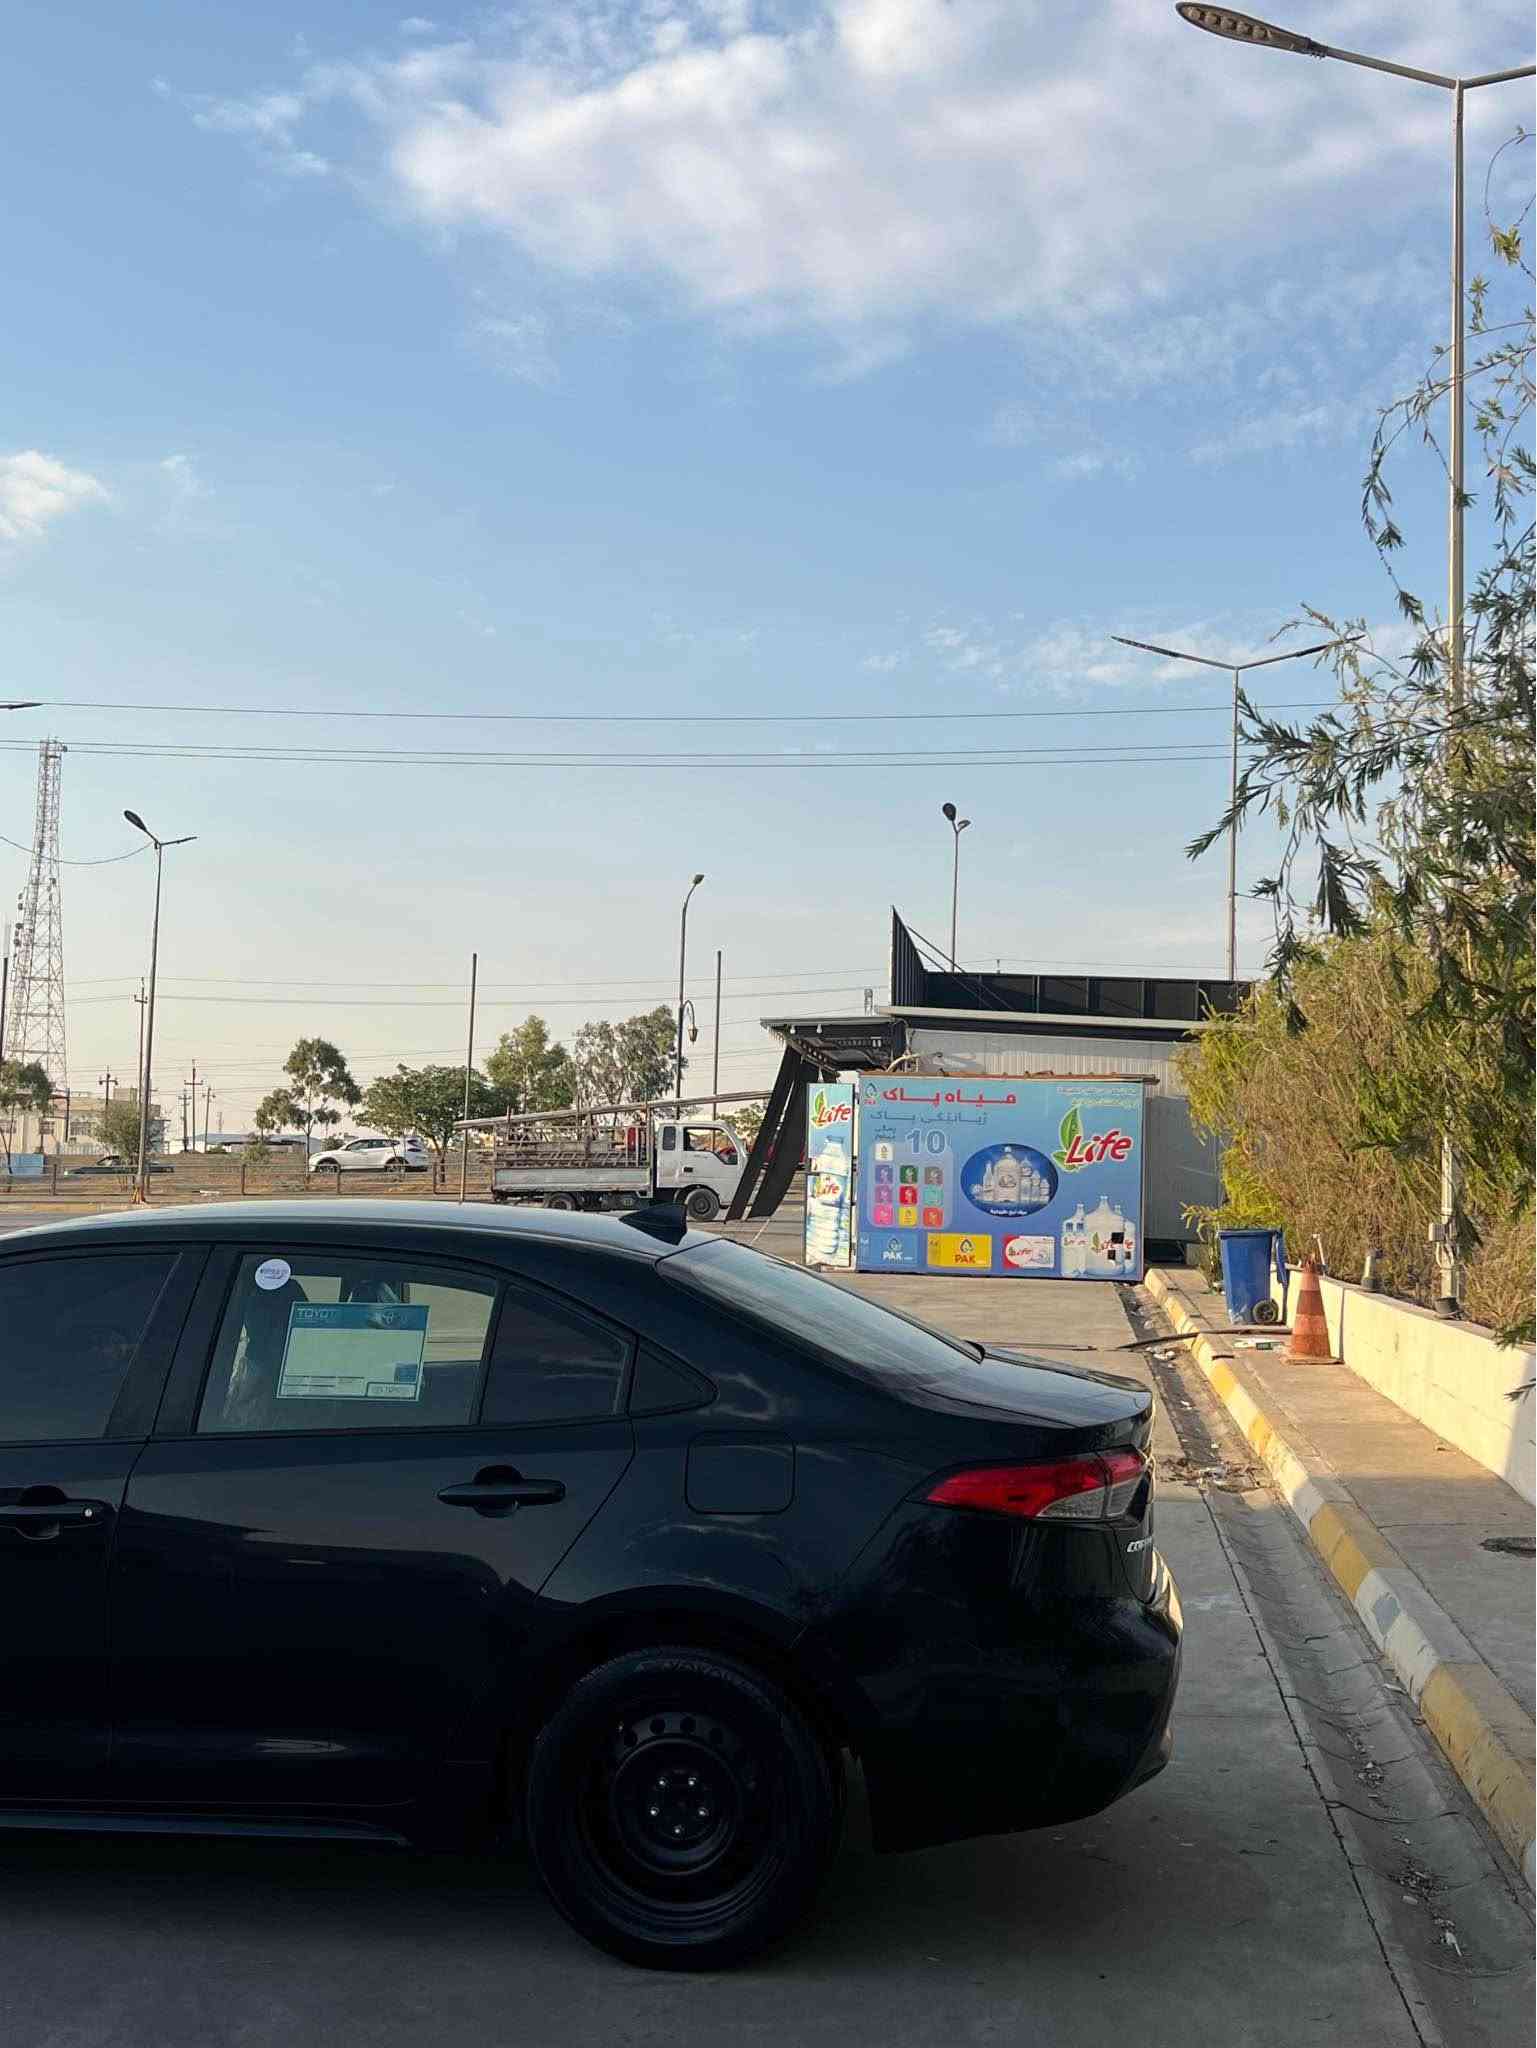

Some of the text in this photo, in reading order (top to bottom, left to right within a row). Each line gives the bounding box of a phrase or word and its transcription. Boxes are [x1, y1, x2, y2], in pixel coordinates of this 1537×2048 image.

[814, 1103, 852, 1126] Life
[906, 1129, 947, 1155] 10
[1065, 1129, 1133, 1164] Life
[815, 1183, 840, 1198] Life
[882, 1250, 903, 1261] PAK
[954, 1254, 976, 1264] PAK
[296, 1307, 339, 1320] TOYOT
